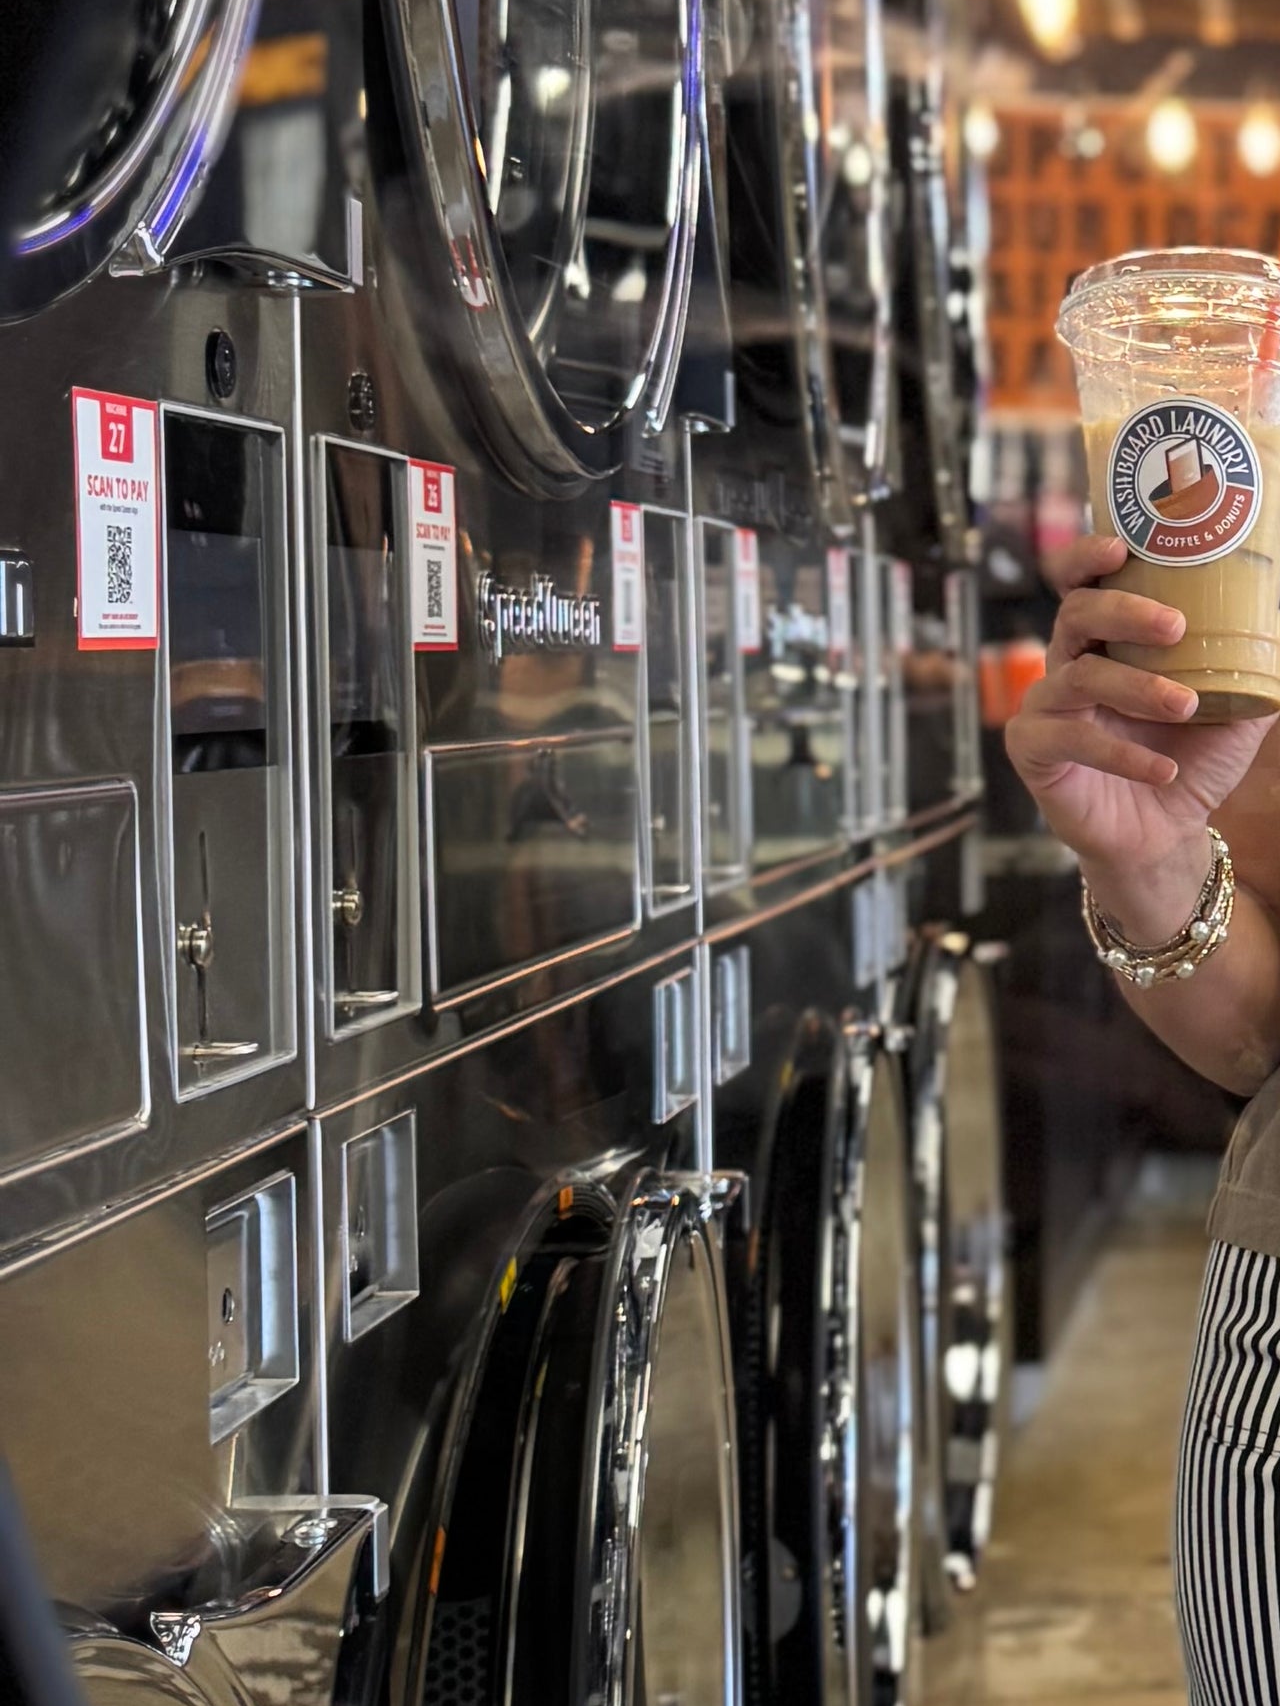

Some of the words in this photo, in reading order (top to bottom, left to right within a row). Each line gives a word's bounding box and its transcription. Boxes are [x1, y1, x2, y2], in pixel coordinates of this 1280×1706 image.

[108, 421, 126, 454] 27
[86, 474, 114, 498] SCAN
[115, 477, 129, 500] TO
[130, 480, 149, 502] PAY
[1115, 415, 1165, 535] WASHBOARD
[1170, 410, 1250, 474] LAUNDRY
[1157, 534, 1201, 548] COFFEE
[1204, 531, 1213, 541] &
[1214, 493, 1246, 536] DONUTS
